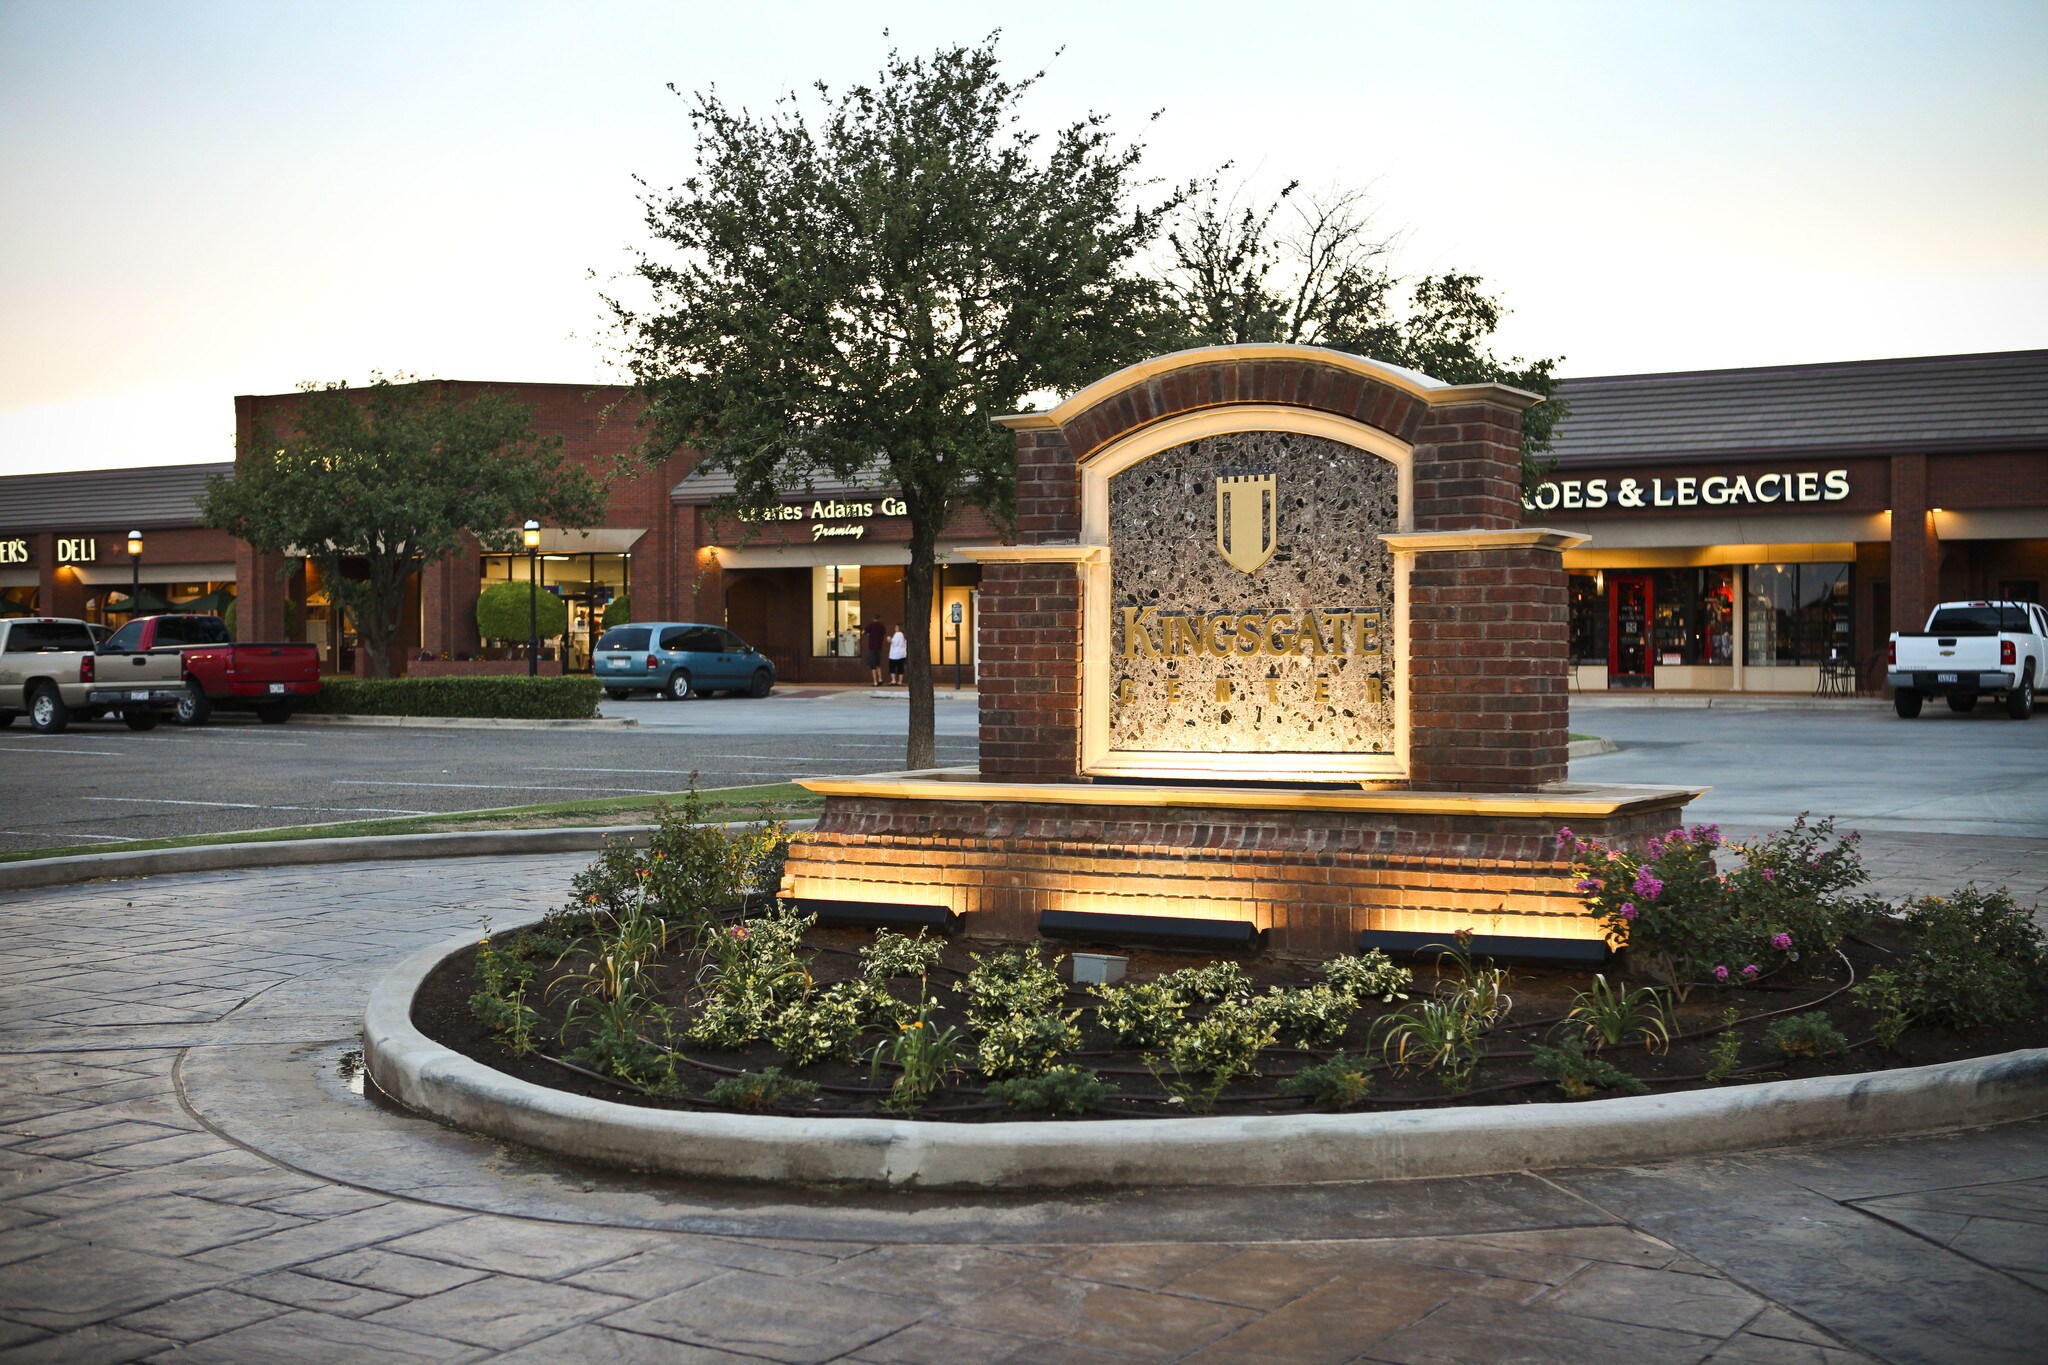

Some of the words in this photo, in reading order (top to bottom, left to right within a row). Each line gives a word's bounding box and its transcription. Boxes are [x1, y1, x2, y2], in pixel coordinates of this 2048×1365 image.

[1618, 479, 1646, 508] &
[1653, 469, 1850, 507] LEGACIES
[810, 499, 874, 519] Adams
[811, 523, 864, 543] Framing
[57, 538, 96, 562] DELI
[1120, 678, 1382, 705] CENTER
